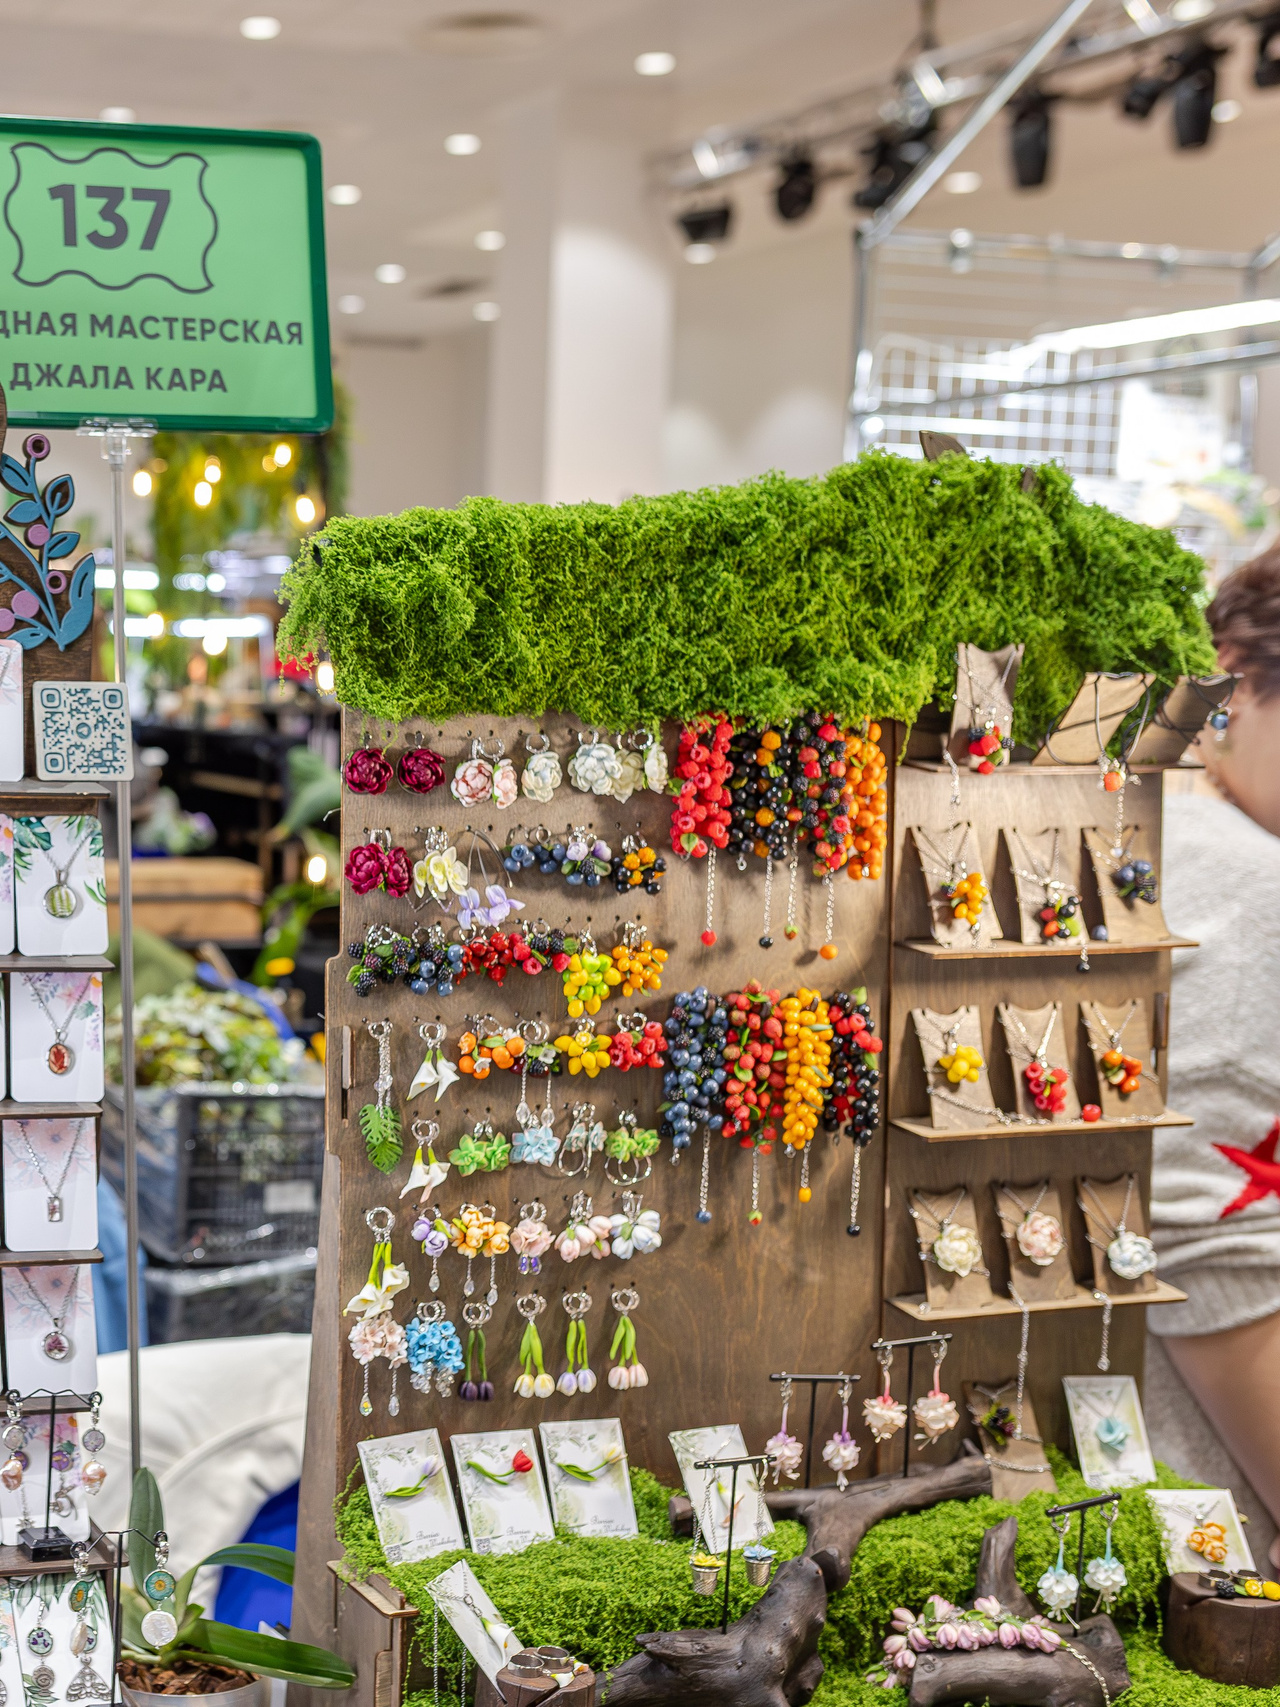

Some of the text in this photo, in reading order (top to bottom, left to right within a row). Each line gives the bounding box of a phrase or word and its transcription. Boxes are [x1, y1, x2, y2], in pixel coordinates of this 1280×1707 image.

[48, 184, 171, 251] 137
[90, 313, 303, 346] МАСТЕРСКАЯ
[9, 363, 228, 393] ДЖАЛА КАРА
